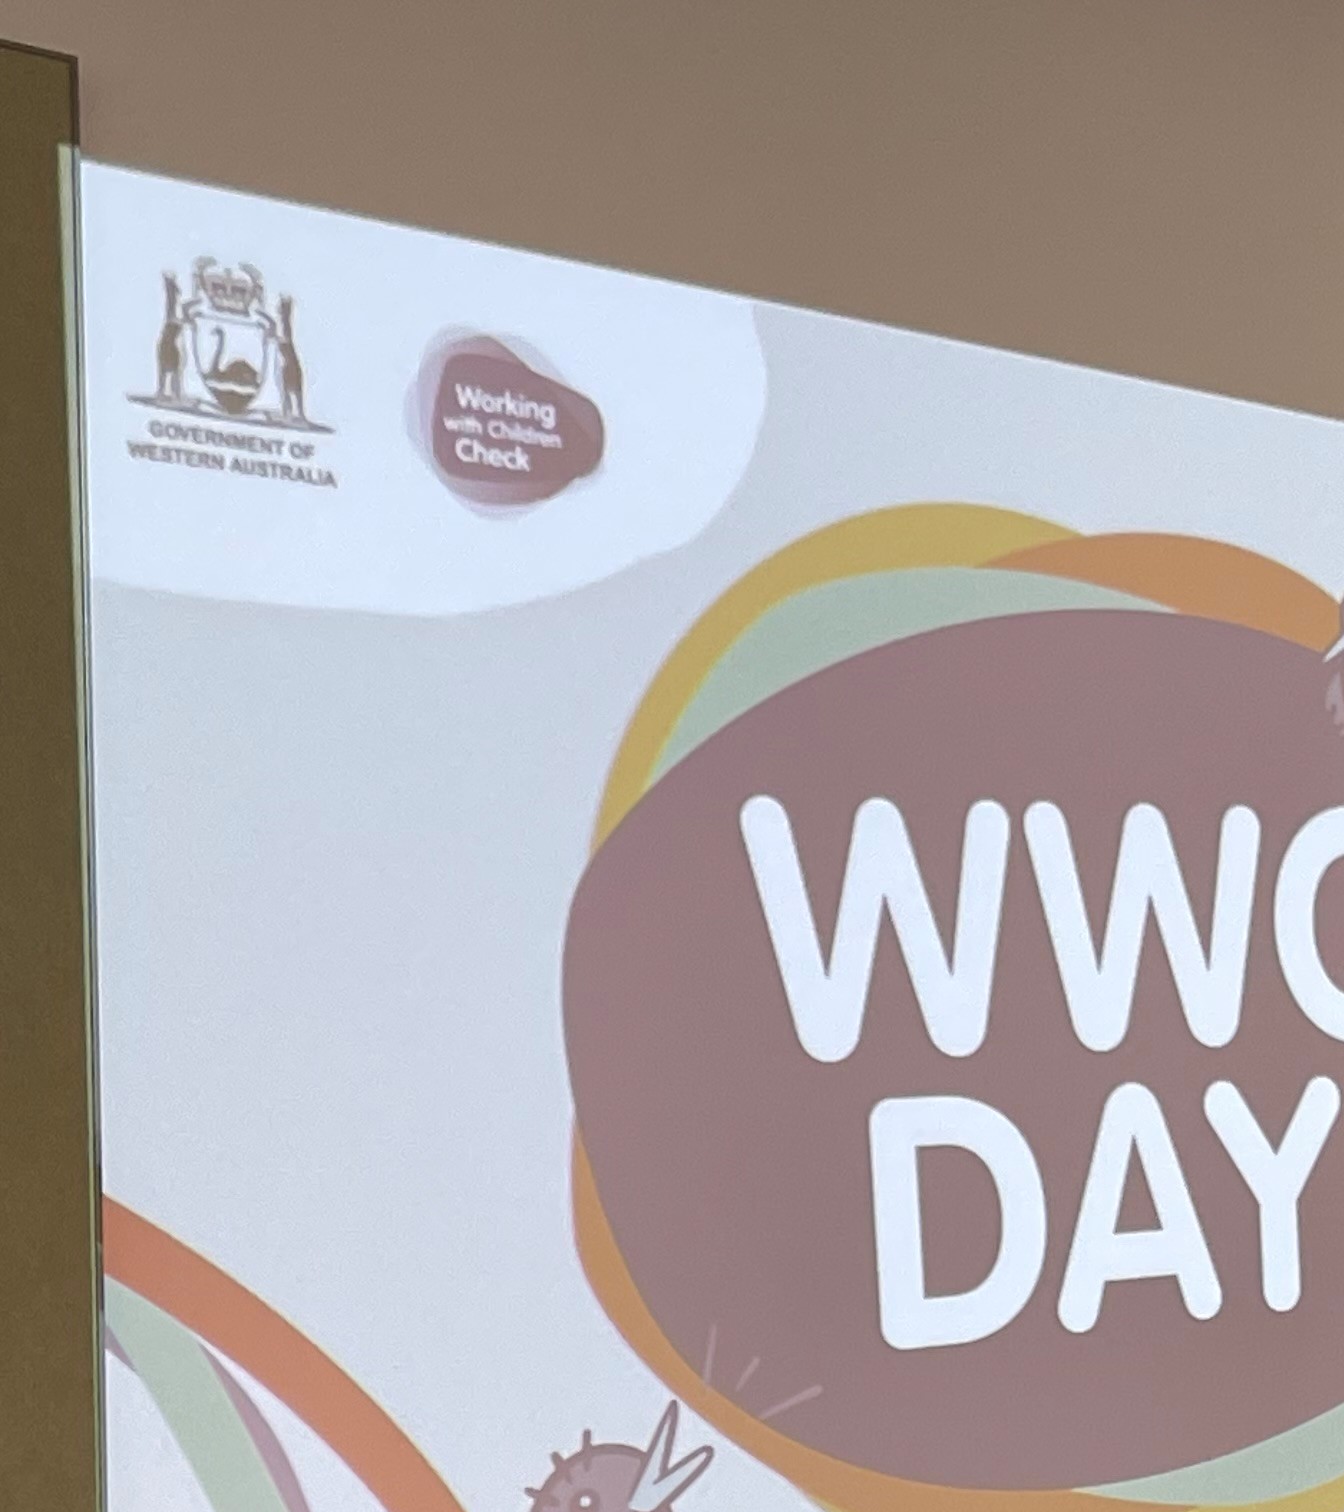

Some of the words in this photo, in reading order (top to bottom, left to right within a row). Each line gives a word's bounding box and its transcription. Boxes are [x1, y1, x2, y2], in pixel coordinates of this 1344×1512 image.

[455, 384, 556, 430] Working
[148, 420, 285, 455] GOVERNMENT
[288, 441, 315, 459] OF
[455, 437, 529, 471] Check
[127, 440, 225, 470] WESTERN
[230, 457, 338, 488] AUSTRALIA
[869, 1076, 1341, 1350] DAY
